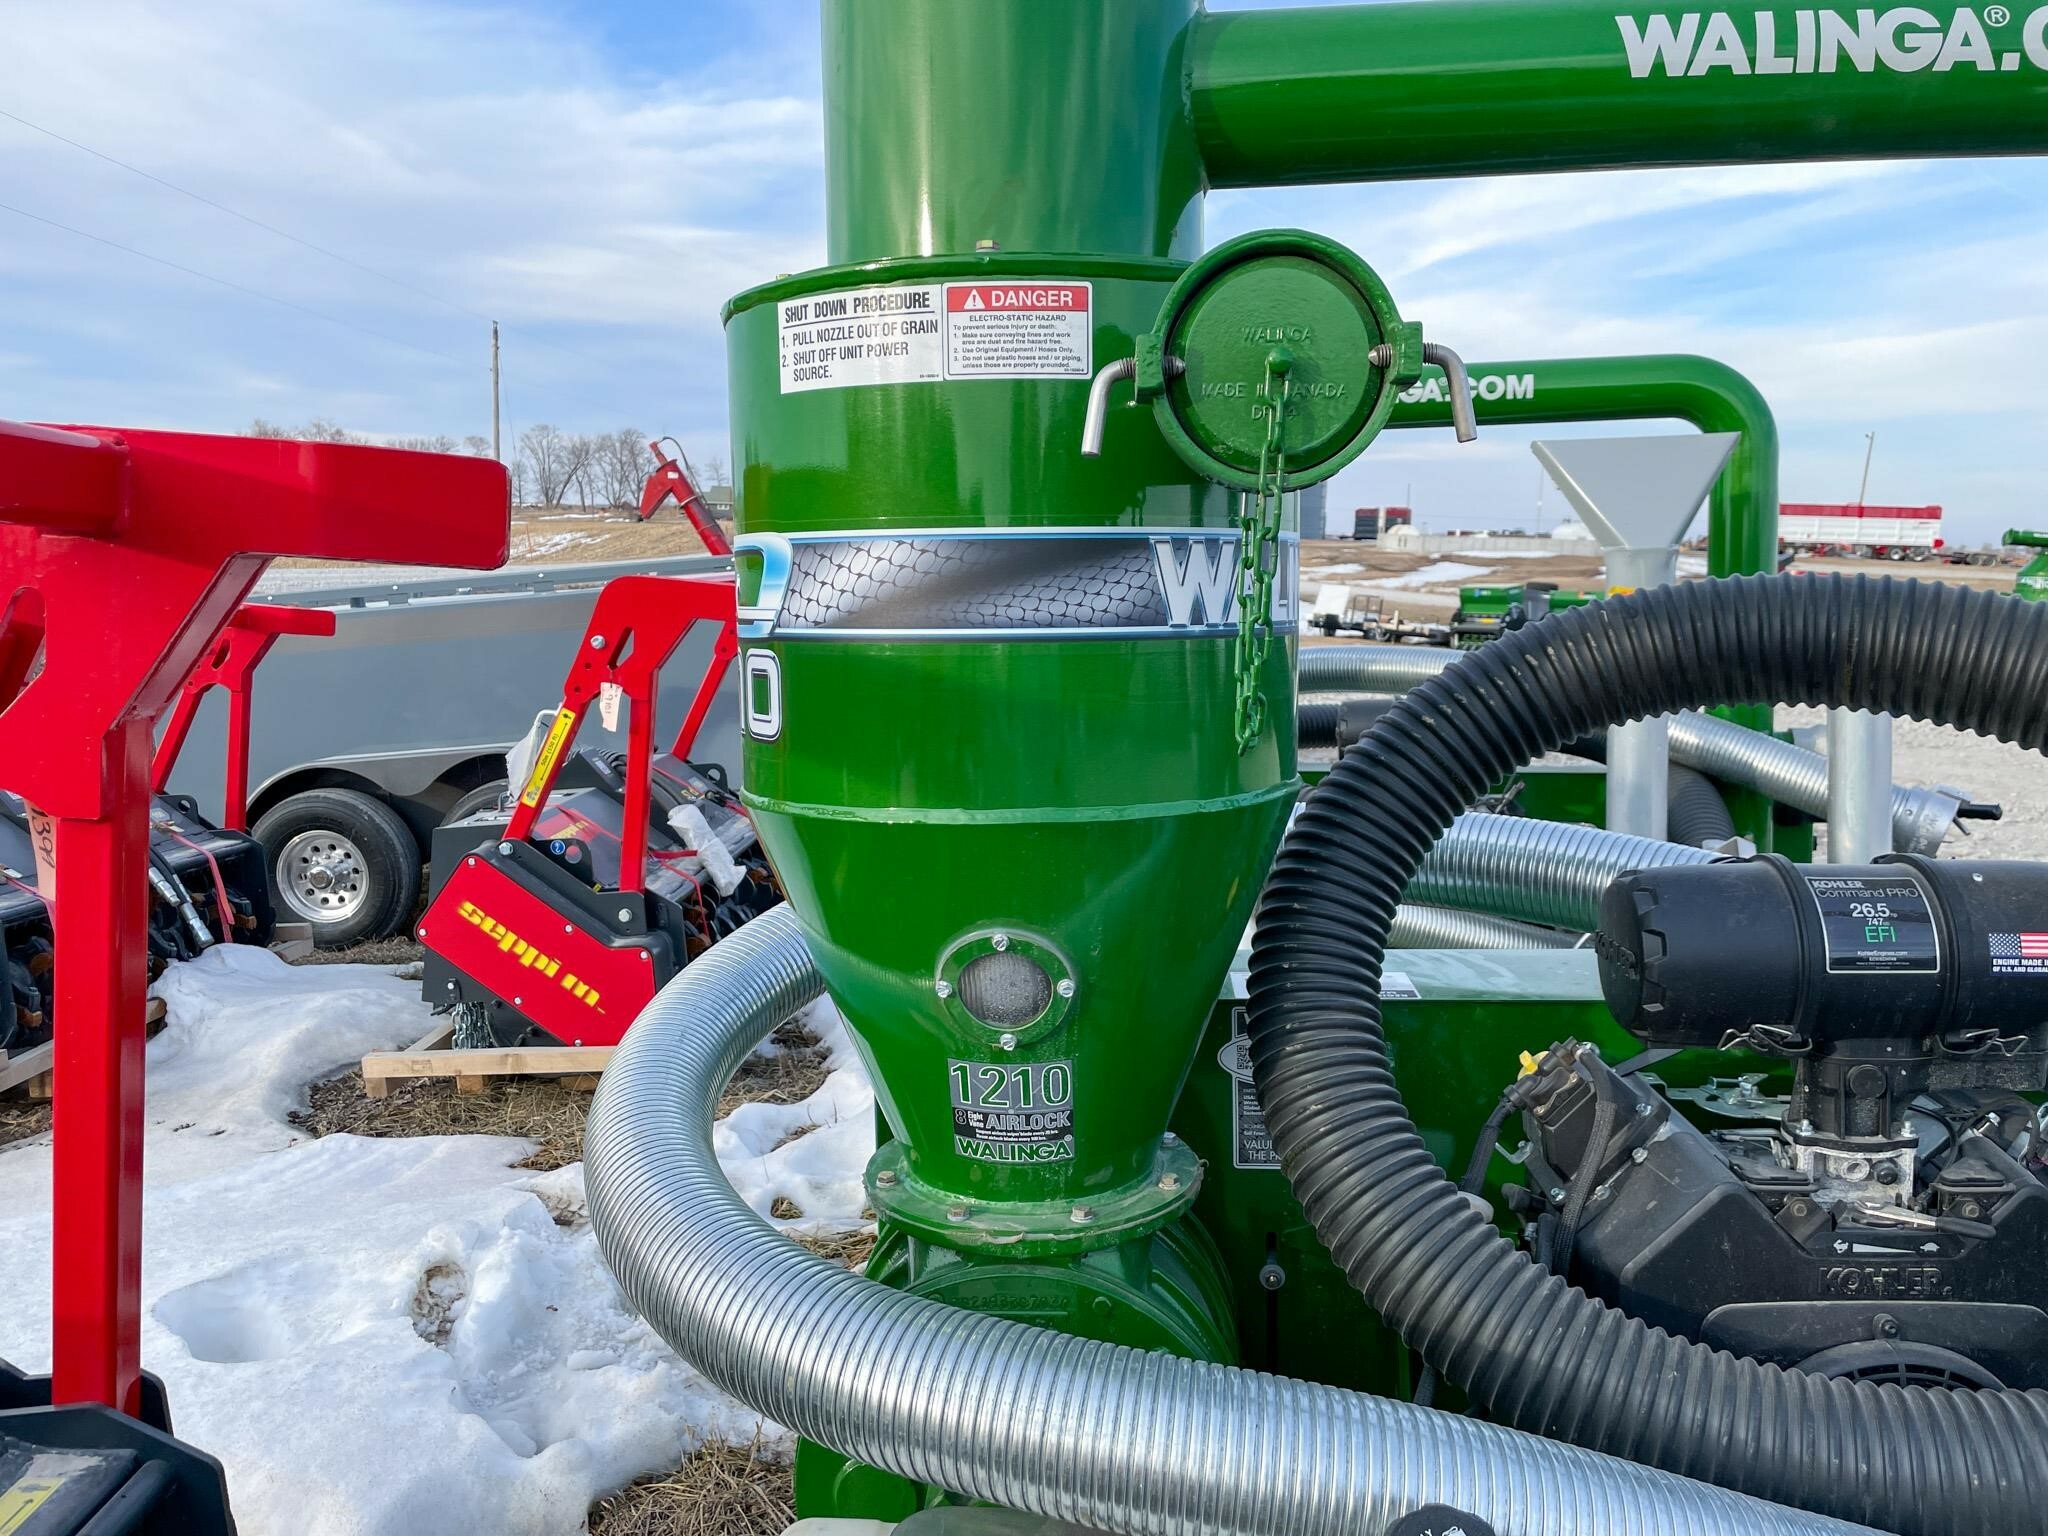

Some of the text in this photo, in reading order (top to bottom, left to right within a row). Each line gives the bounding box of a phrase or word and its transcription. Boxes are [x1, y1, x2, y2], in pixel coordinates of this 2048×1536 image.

[991, 290, 1073, 307] DANGER
[785, 292, 930, 323] SHUT DOWN PROCEDURE
[781, 319, 938, 348] 1. PULL NOZZLE OUT OF GRAIN
[782, 341, 909, 367] 2. SHUT OFF UNIT POWER
[793, 365, 832, 382] SOURCE.
[1202, 382, 1248, 398] MADE
[1285, 382, 1348, 398] ANADA
[1811, 880, 1865, 888] KOHLER
[1815, 888, 1919, 898] Command PRO
[1849, 903, 1890, 917] 26.5
[1866, 918, 1883, 926] 747
[1864, 926, 1896, 943] EFI
[950, 1063, 1071, 1108] 1210
[967, 1111, 984, 1121] Eight
[985, 1110, 1071, 1131] AIRLOCK
[1248, 1151, 1267, 1160] THE
